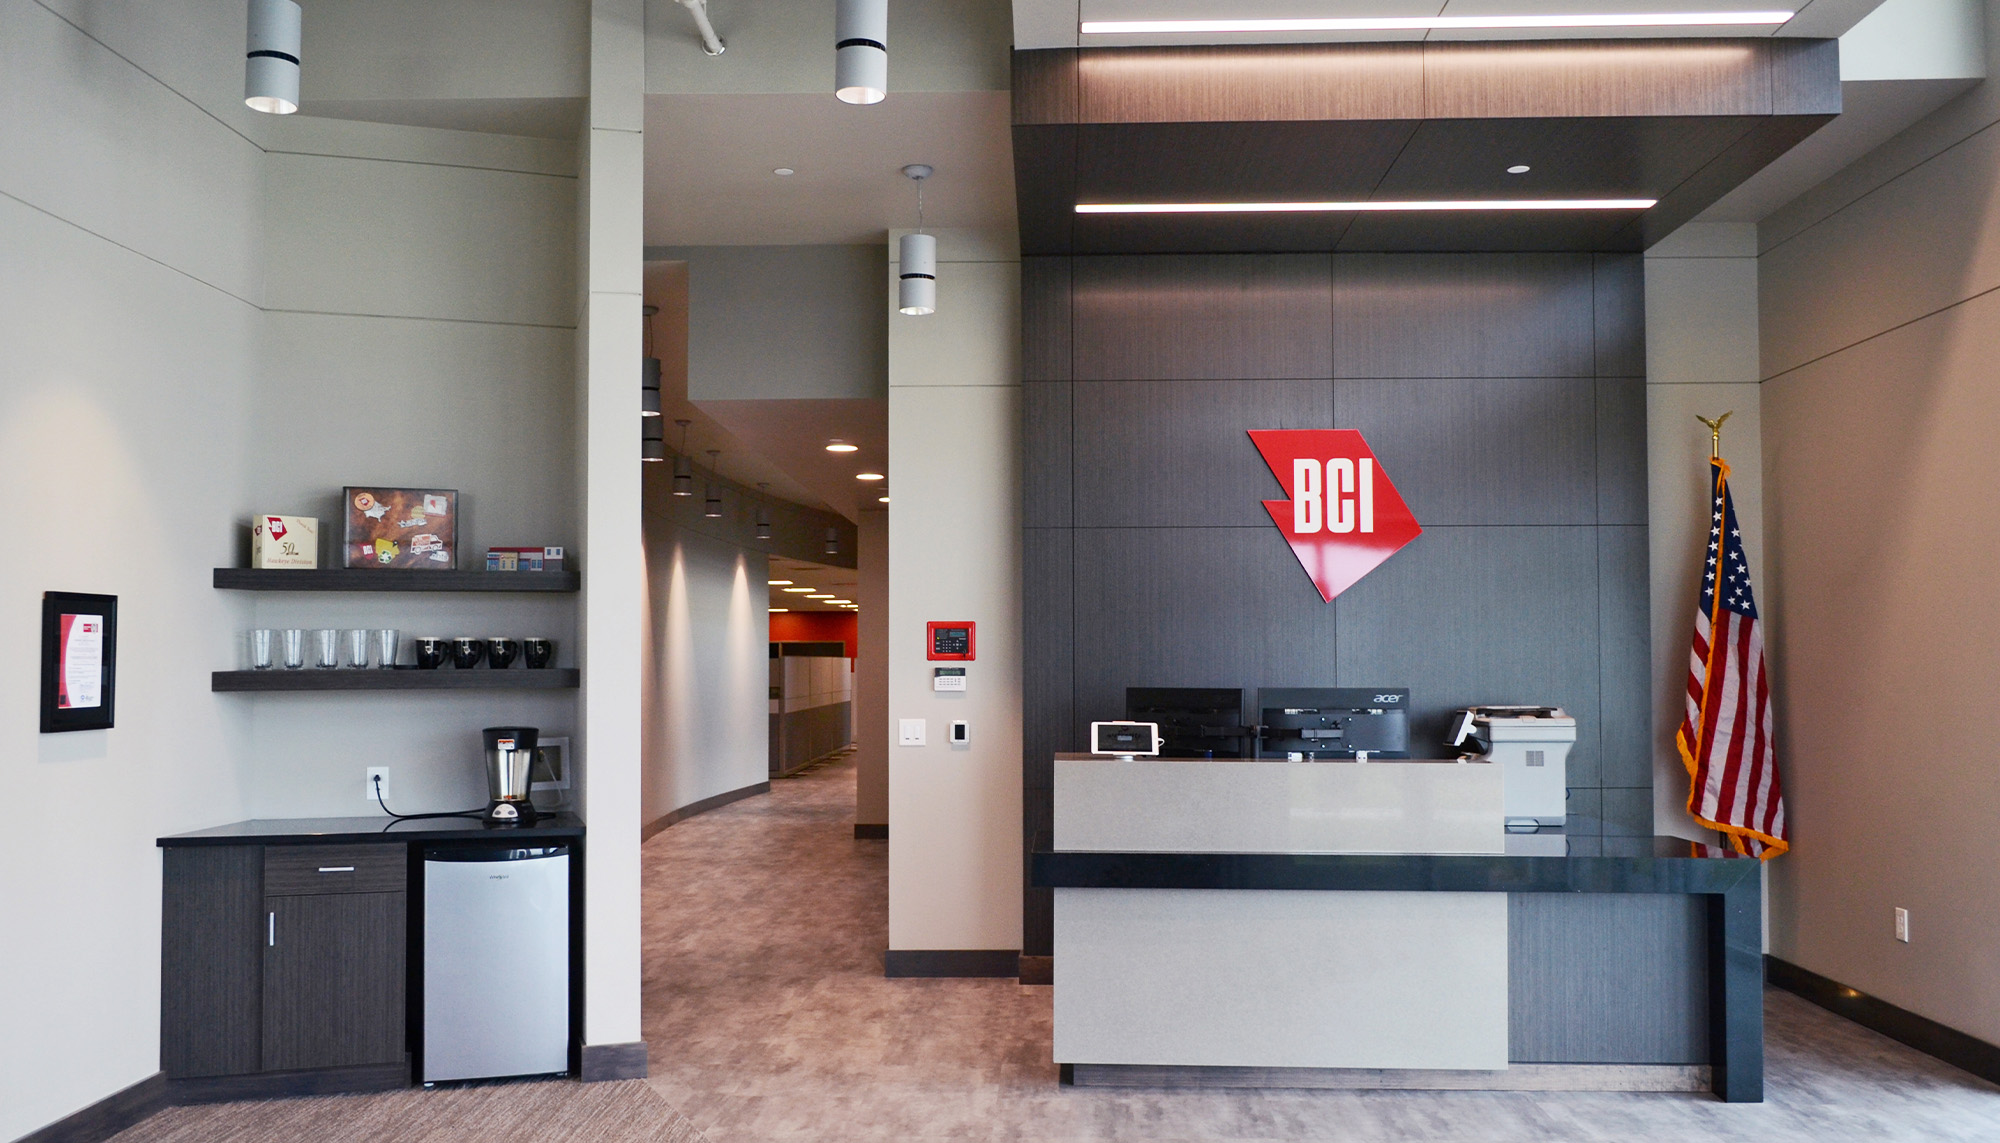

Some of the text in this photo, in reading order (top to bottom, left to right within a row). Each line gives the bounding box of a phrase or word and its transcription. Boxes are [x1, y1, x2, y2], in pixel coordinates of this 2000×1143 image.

[1293, 457, 1374, 533] BCI
[280, 541, 296, 555] 50
[1373, 694, 1403, 703] acer
